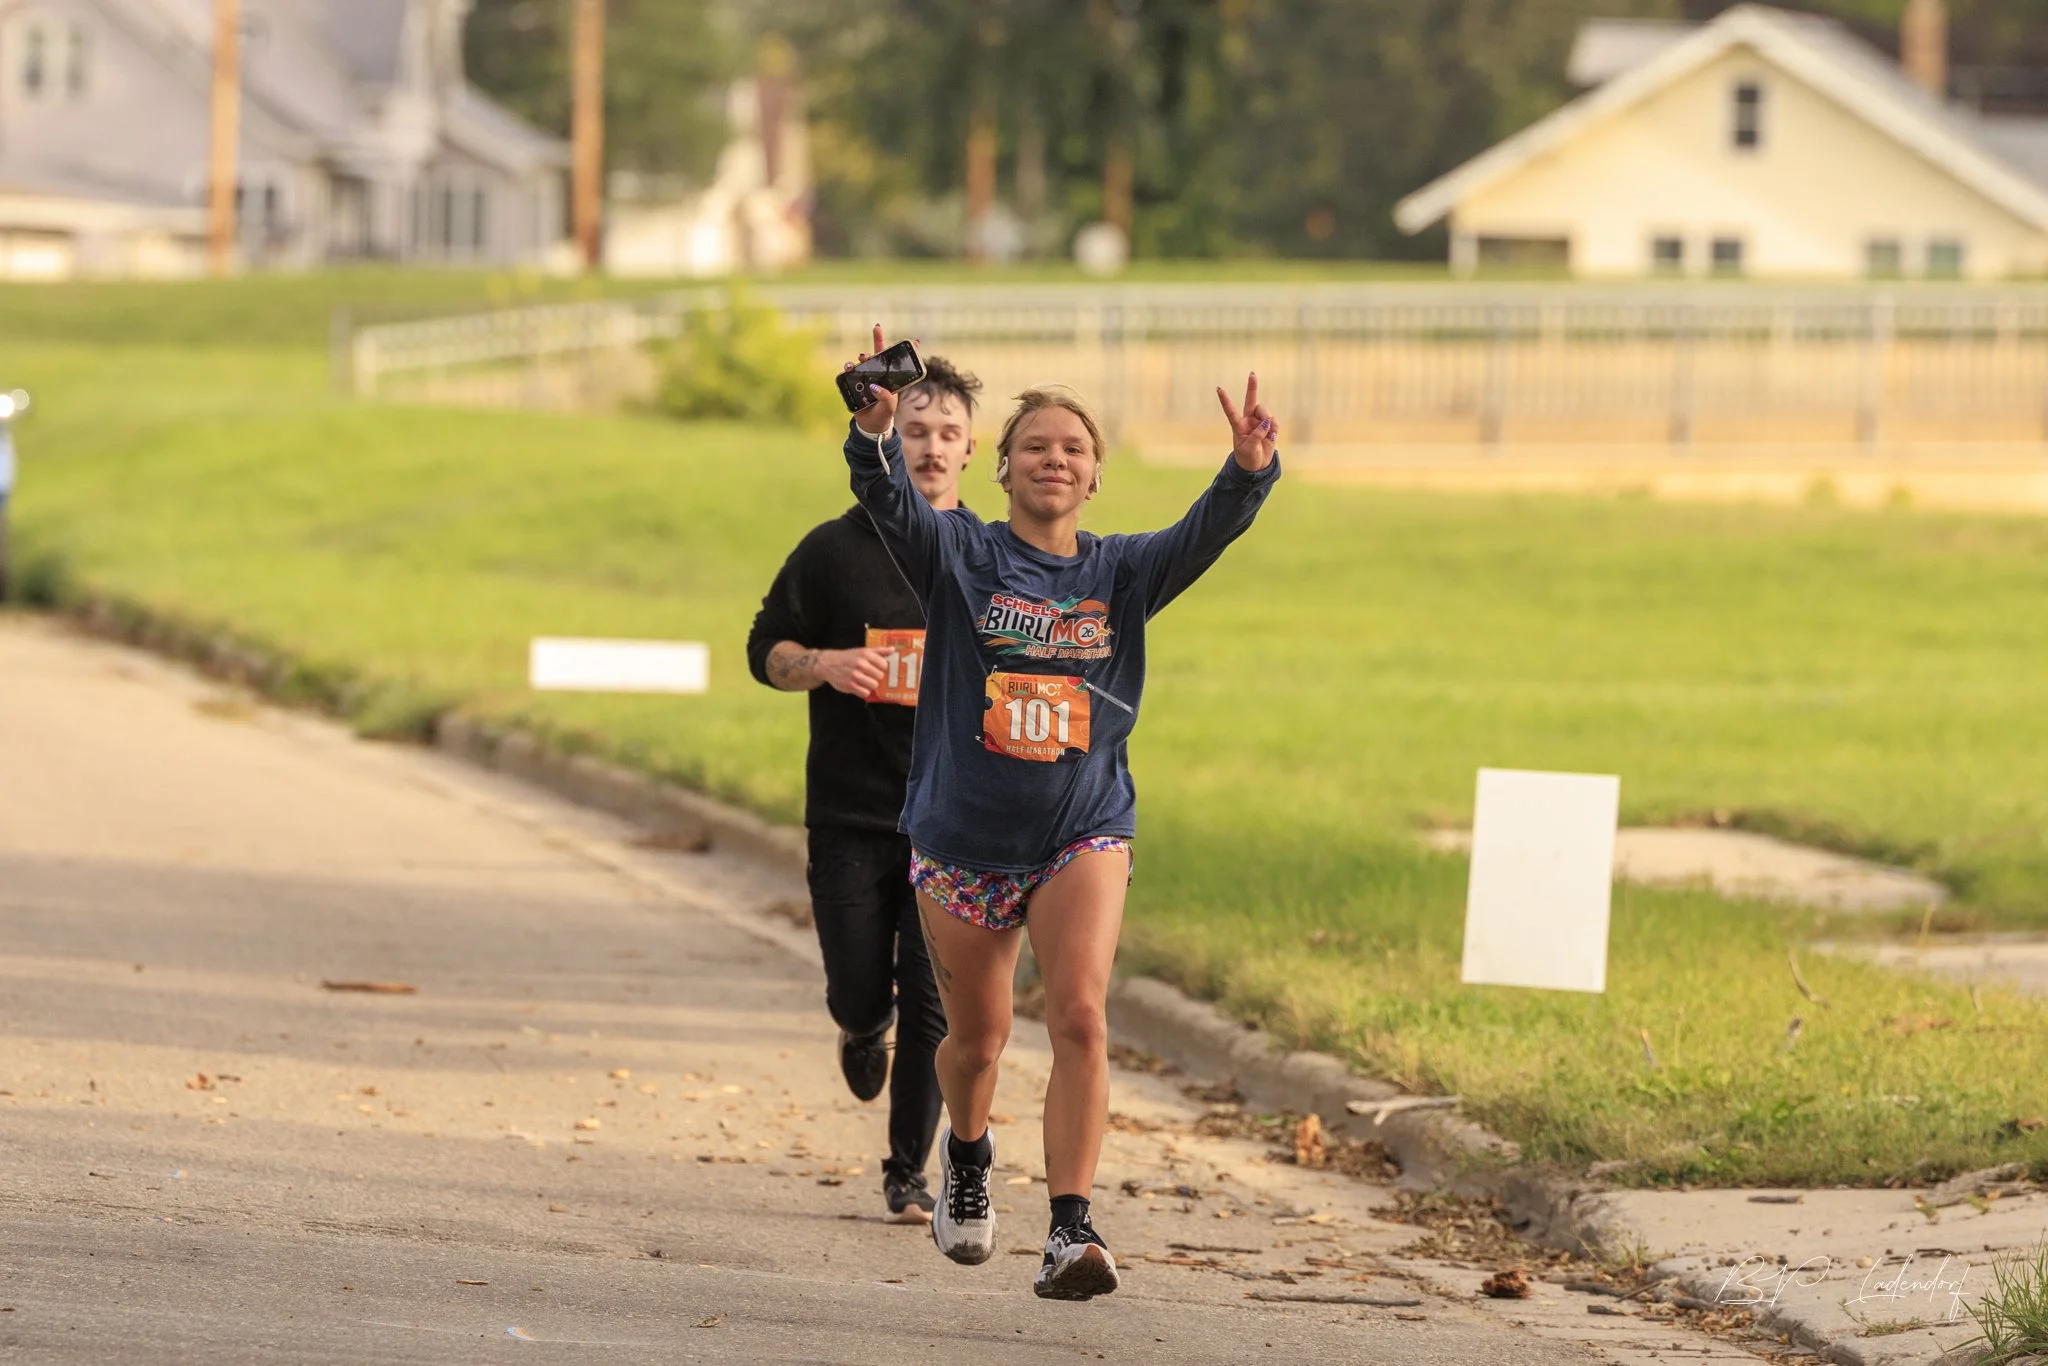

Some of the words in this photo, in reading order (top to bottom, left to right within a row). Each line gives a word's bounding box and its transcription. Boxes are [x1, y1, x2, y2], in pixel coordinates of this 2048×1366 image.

[992, 593, 1061, 618] SCHEELS
[1081, 626, 1094, 638] 26
[1025, 644, 1057, 657] HALF
[1058, 646, 1112, 659] MARATHON
[884, 651, 924, 689] 11
[1005, 697, 1070, 743] 101
[1006, 745, 1025, 754] HALF
[1026, 746, 1065, 757] MARATHON
